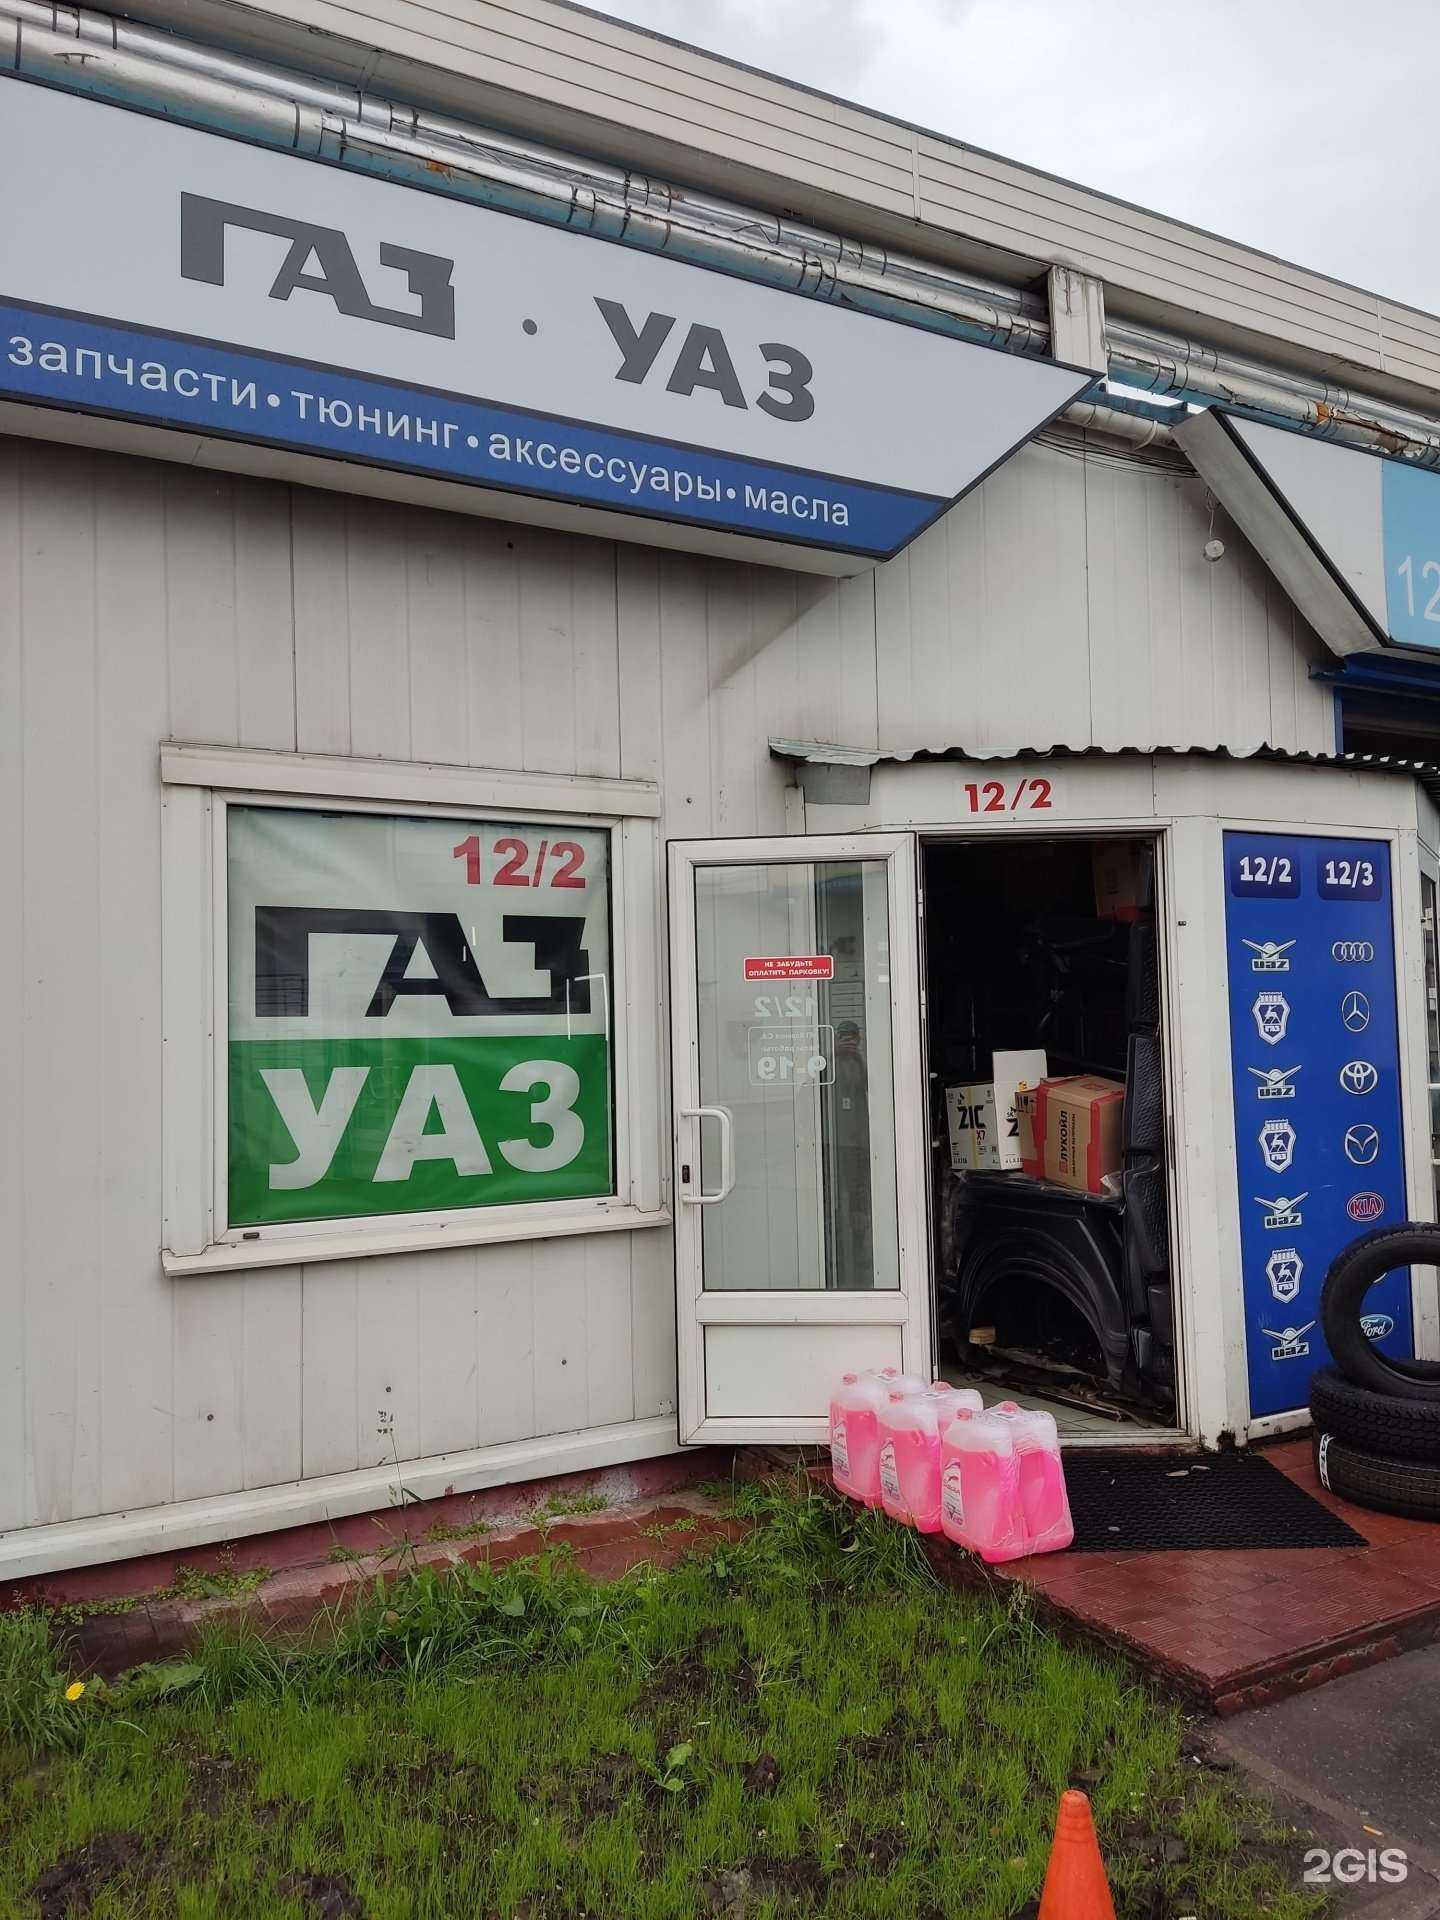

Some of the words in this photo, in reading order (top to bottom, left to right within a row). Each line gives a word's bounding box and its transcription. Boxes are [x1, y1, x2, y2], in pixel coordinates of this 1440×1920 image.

[181, 191, 456, 340] ГАЗ
[593, 296, 815, 422] УАЗ
[8, 335, 257, 410] запчасти
[291, 391, 459, 449] тюнинг
[488, 432, 722, 503] аксессуары
[745, 486, 849, 526] масла
[964, 778, 1052, 813] 12/2
[453, 835, 586, 889] 12/2
[1239, 856, 1292, 885] 12/2
[1325, 860, 1374, 888] 12/3
[255, 905, 592, 1018] ГАЗ
[748, 969, 787, 977] ОПЛАТИТЬ
[259, 1059, 586, 1190] УАЗ
[957, 1104, 986, 1130] ZIC
[1059, 1110, 1068, 1162] ЛУКОЙЛ
[1352, 1198, 1380, 1216] KIA
[1361, 1319, 1386, 1337] Ford
